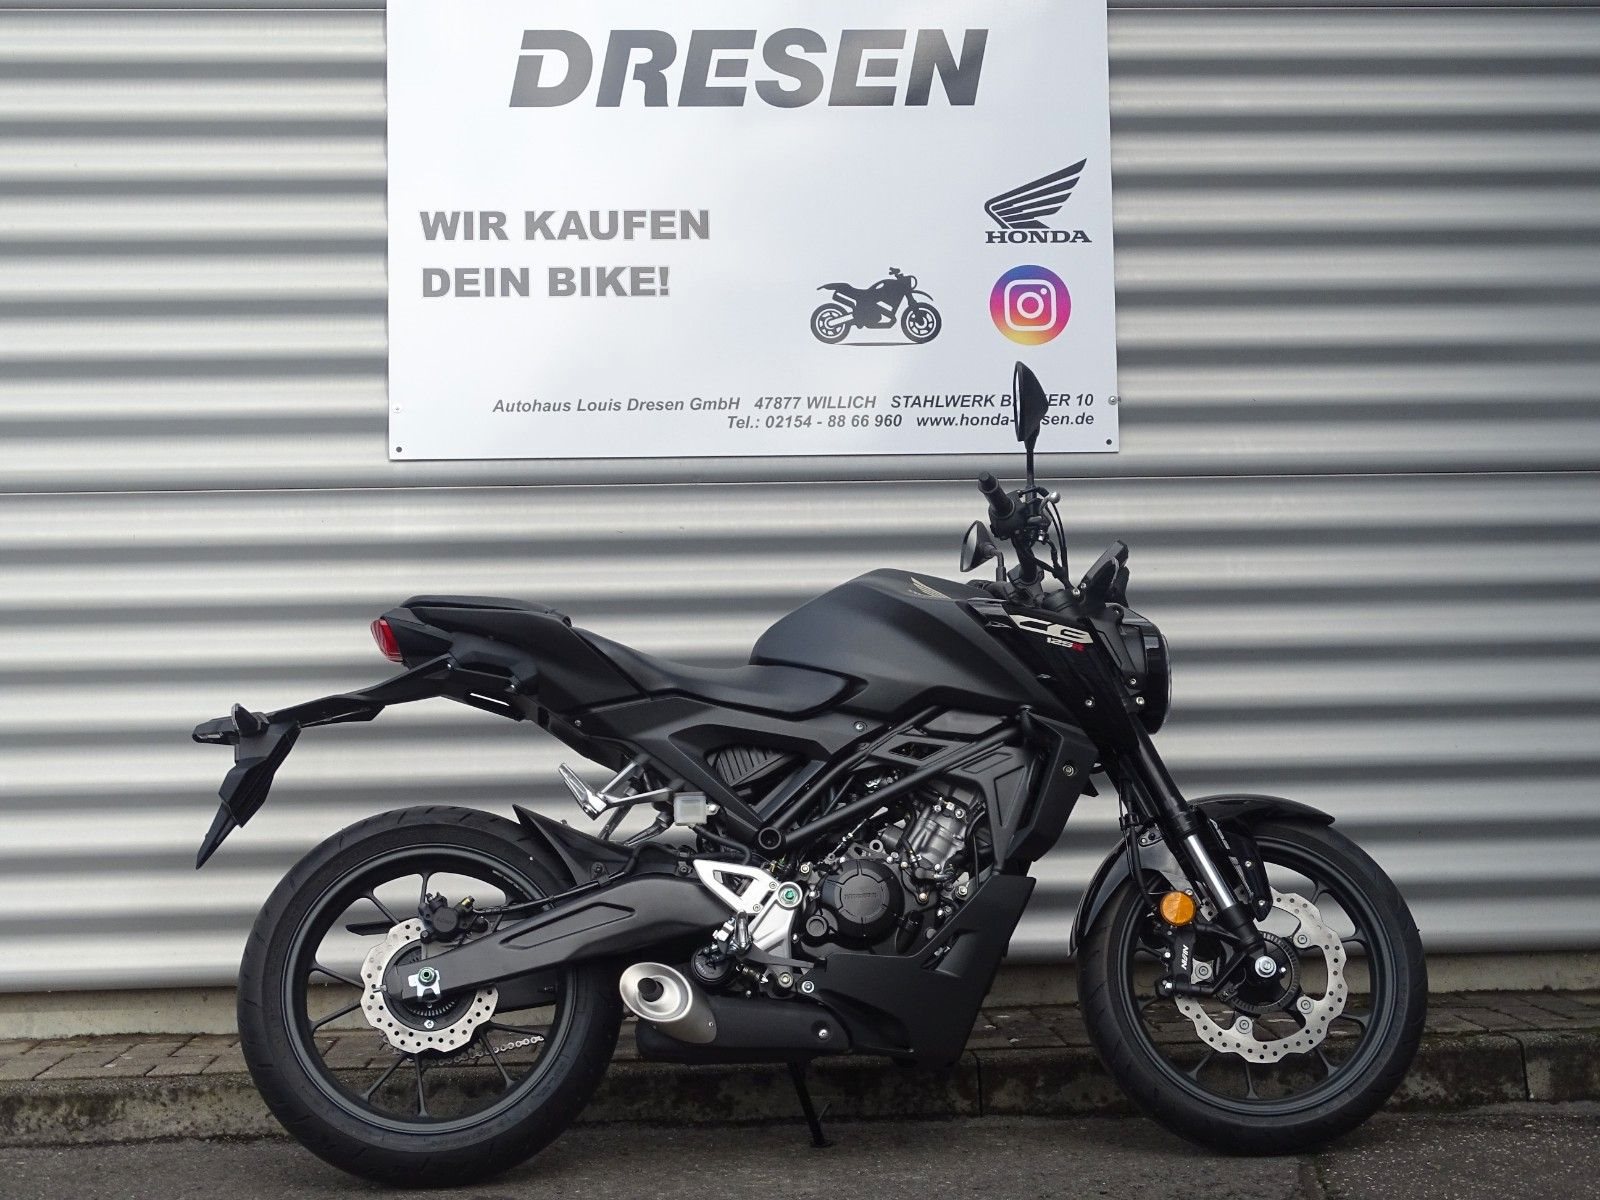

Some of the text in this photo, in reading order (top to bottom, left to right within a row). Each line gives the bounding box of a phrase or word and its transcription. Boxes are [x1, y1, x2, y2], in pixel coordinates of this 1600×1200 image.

[509, 28, 989, 108] DRESEN
[419, 208, 711, 241] WIR KAUFEN
[985, 230, 1092, 244] HONDA
[422, 265, 670, 298] DEIN BIKE!
[493, 393, 1094, 413] Autohaus Louis Dresen GmbH 47877 WILLICH STAHLWERK BER 10
[727, 414, 761, 429] Tel.:
[765, 414, 812, 429] 02154
[827, 414, 846, 428] 88
[851, 414, 870, 428] 66
[874, 413, 903, 428] 960
[916, 411, 1095, 427] www.honda-sen.de
